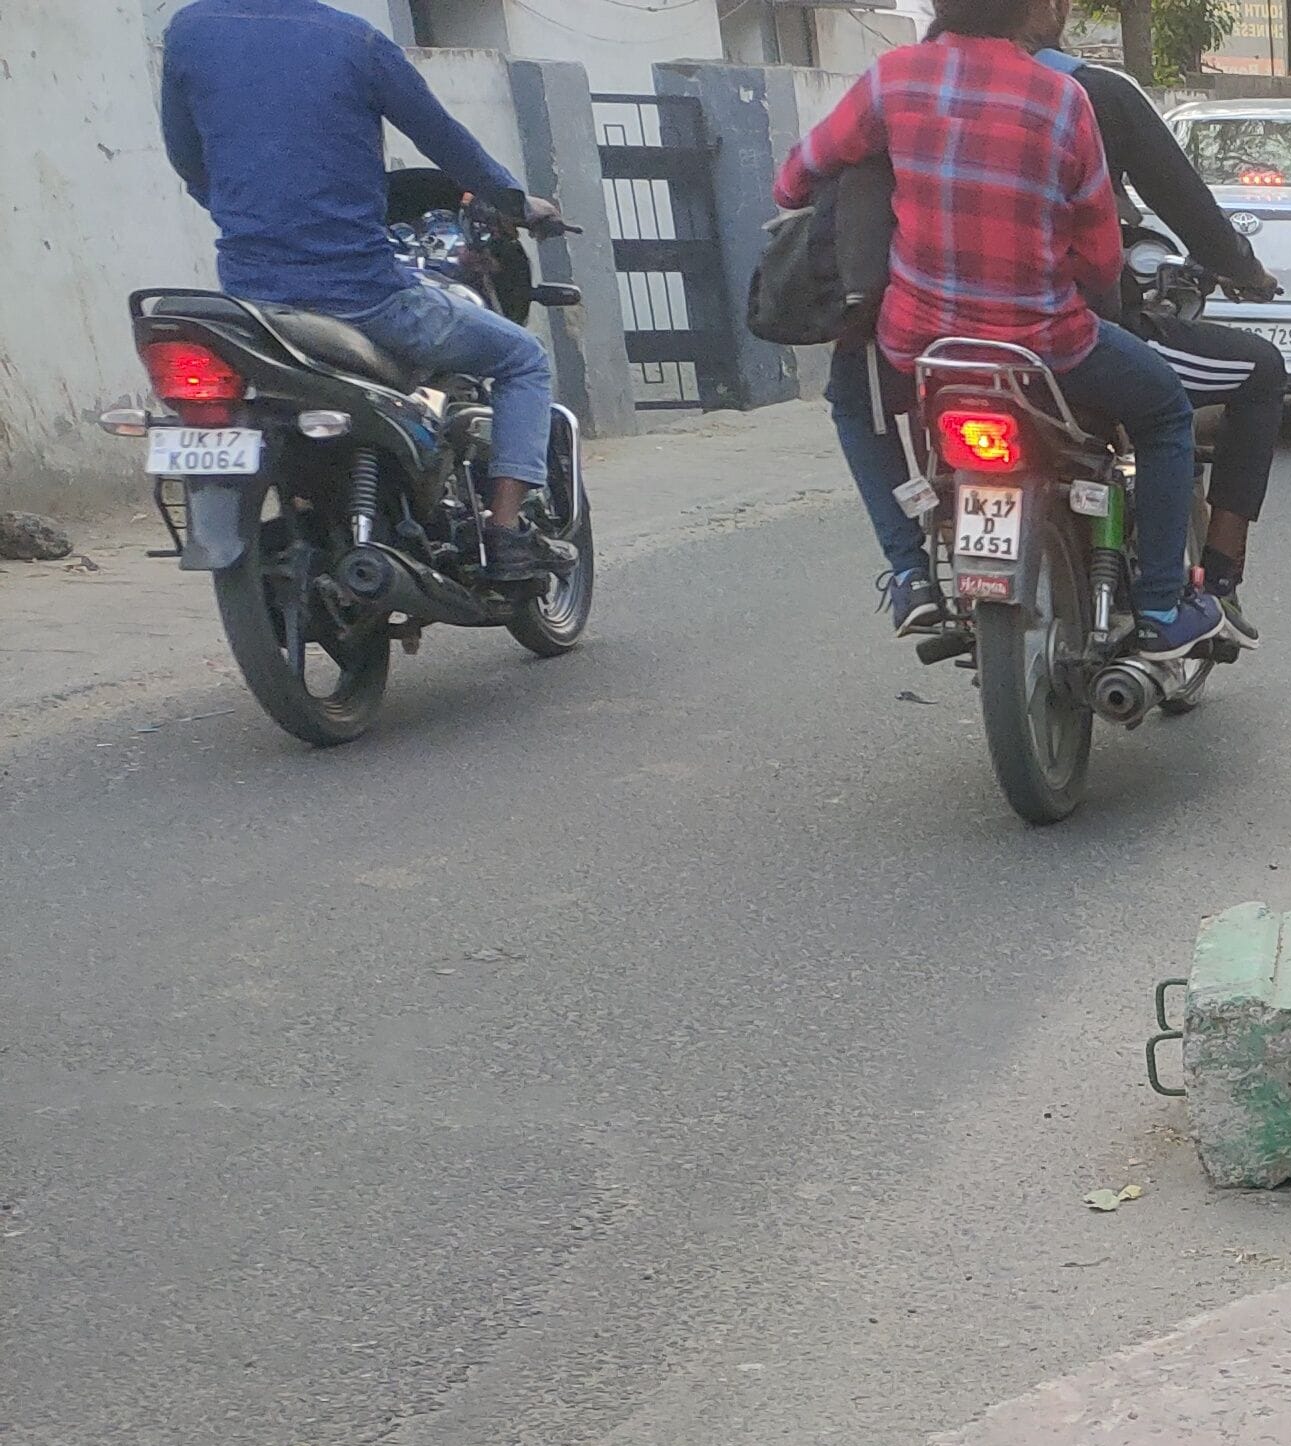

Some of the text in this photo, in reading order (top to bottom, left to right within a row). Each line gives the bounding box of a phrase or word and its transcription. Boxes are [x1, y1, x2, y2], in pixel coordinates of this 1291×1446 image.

[180, 431, 241, 448] UK17
[168, 450, 246, 470] K0064
[984, 518, 995, 534] D
[960, 535, 1012, 555] 1651
